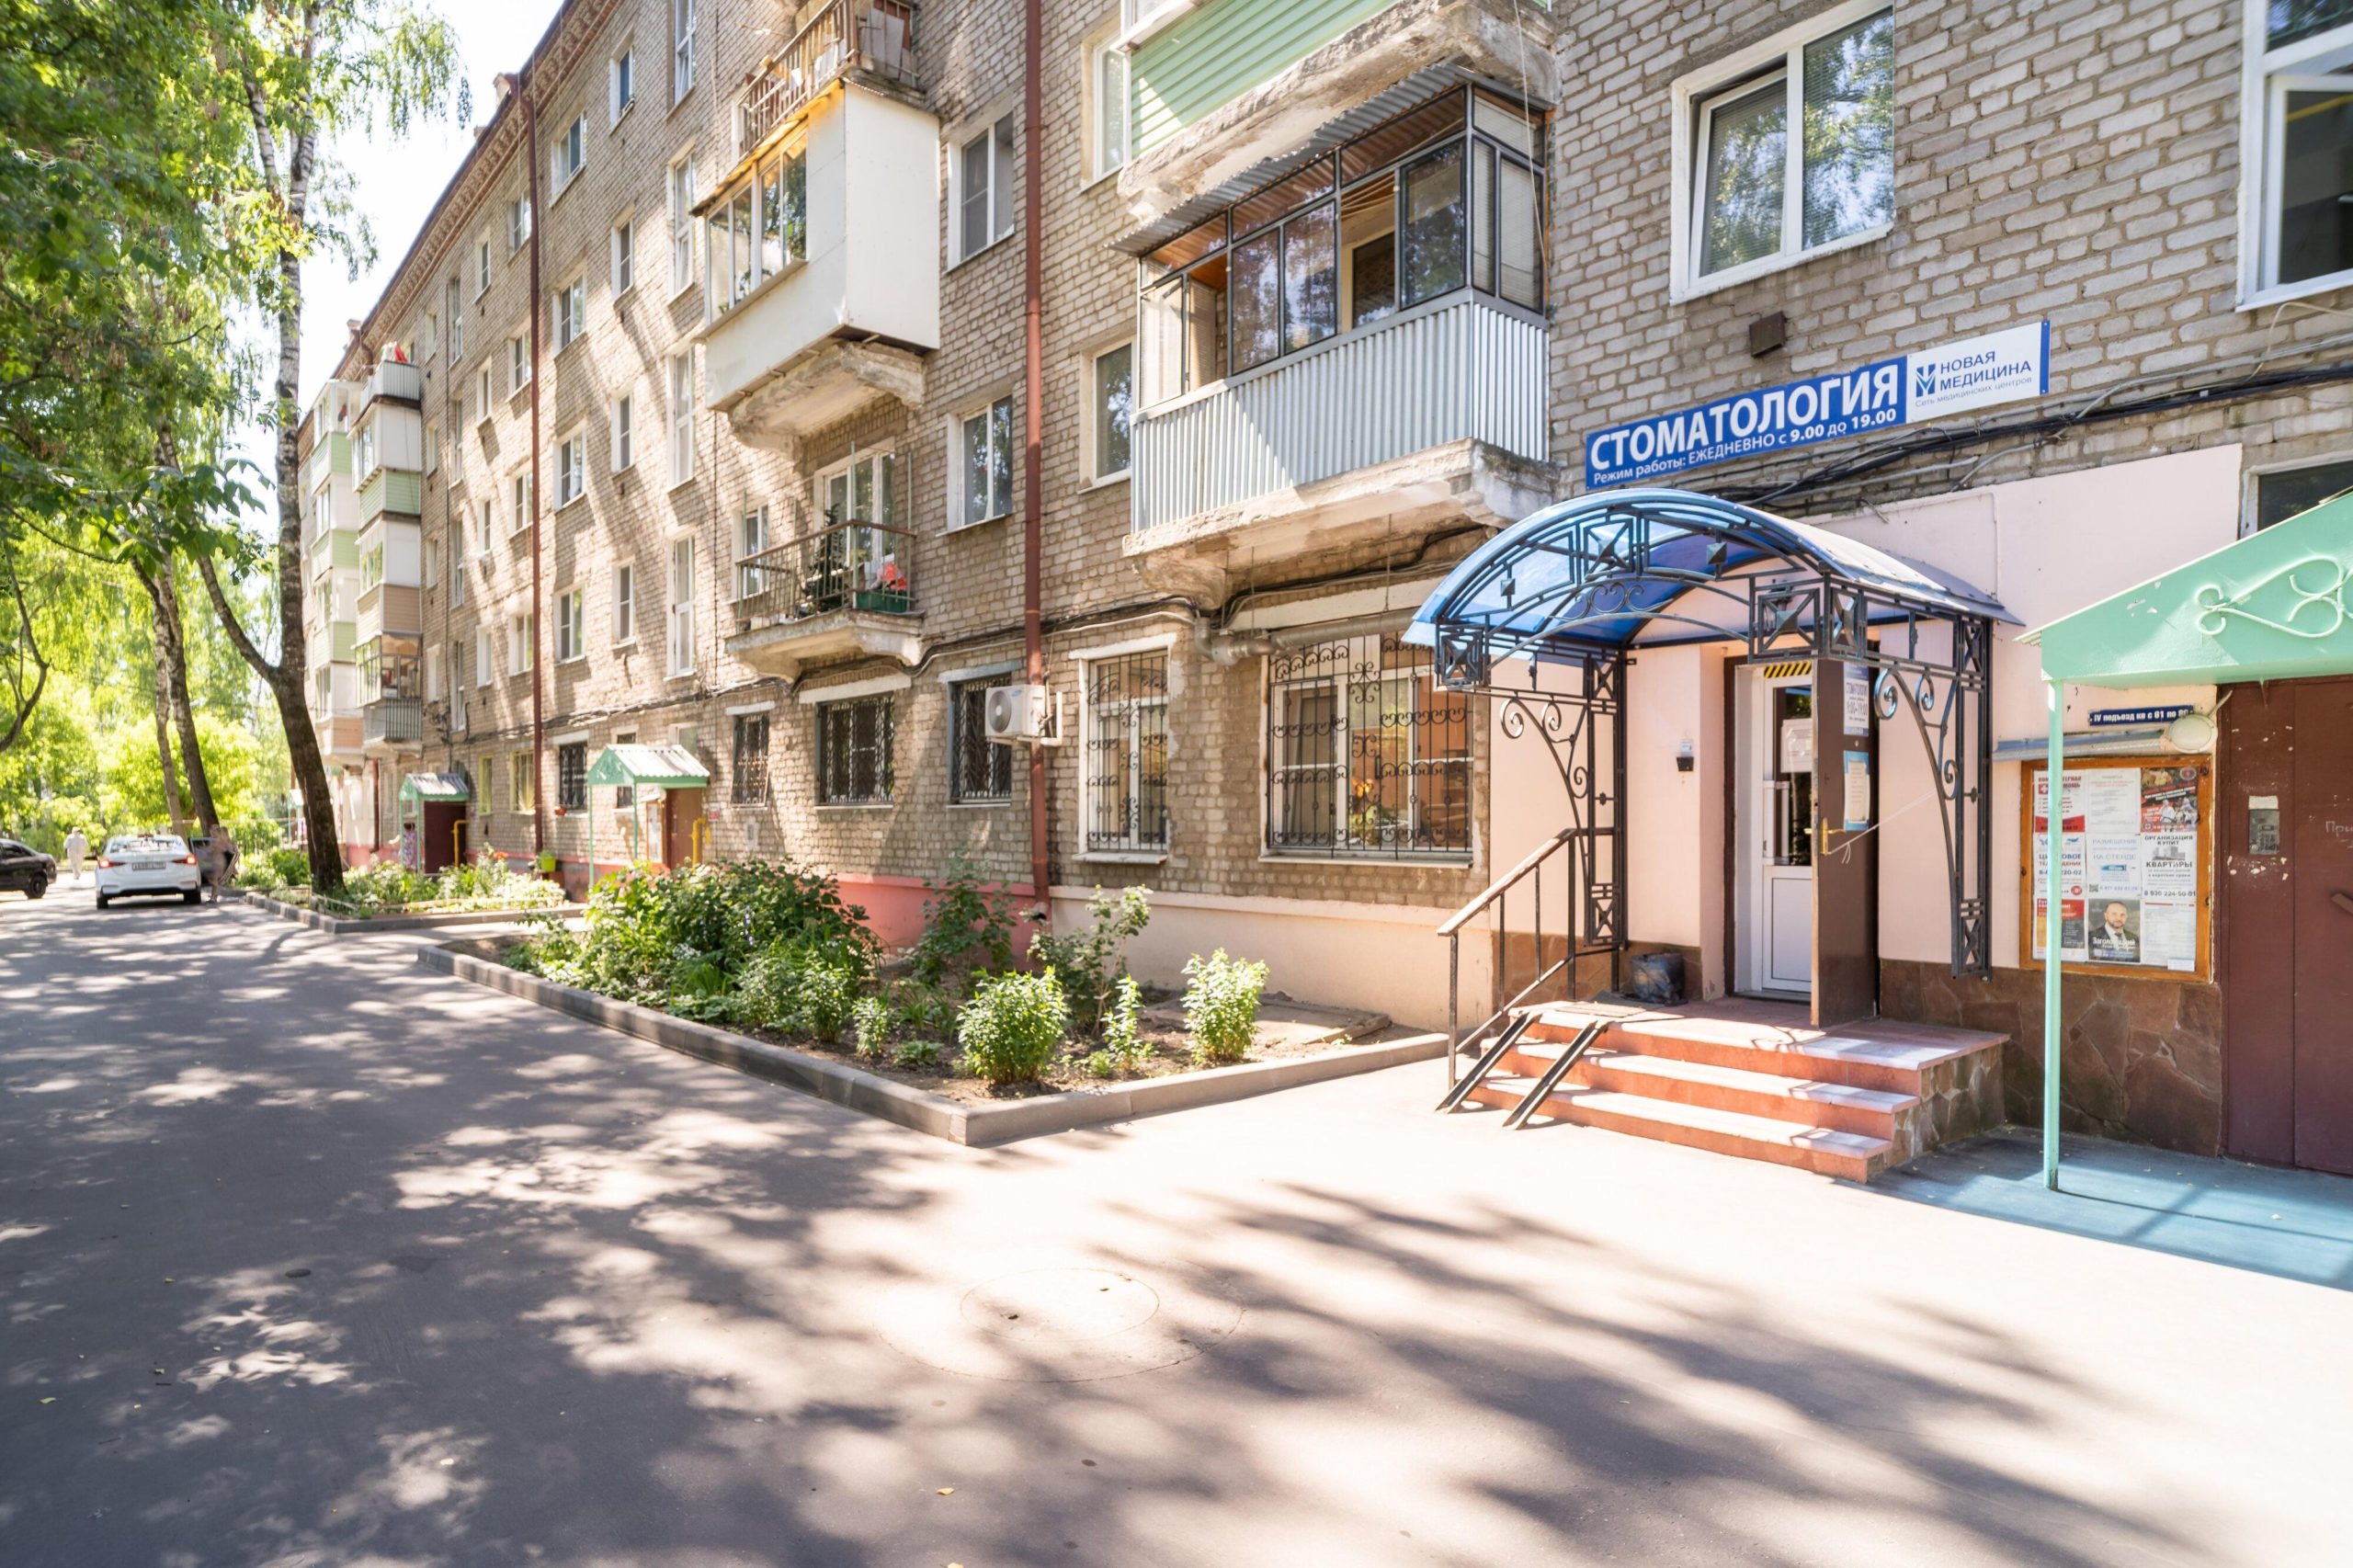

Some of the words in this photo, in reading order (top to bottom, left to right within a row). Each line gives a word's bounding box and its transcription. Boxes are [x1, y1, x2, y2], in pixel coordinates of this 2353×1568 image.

[1940, 351, 1995, 374] НОВАЯ
[1940, 360, 2031, 392] МЕДИЦИНА
[1915, 398, 1935, 407] Сеть
[1937, 385, 1992, 403] медицинских
[1995, 377, 2032, 391] центров
[1591, 365, 1898, 470] СТОМАТОЛОГИЯ
[1594, 468, 1632, 484] Режим
[1636, 457, 1686, 478] работы:
[1688, 433, 1775, 464] ЕЖЕДНЕВНО
[1779, 434, 1787, 444] с
[1790, 425, 1824, 442] 9.00
[1827, 422, 1847, 437] до
[1851, 409, 1896, 429] 19.00
[2094, 714, 2101, 722] IV
[2103, 712, 2134, 722] подъезд
[2136, 712, 2145, 721] кв
